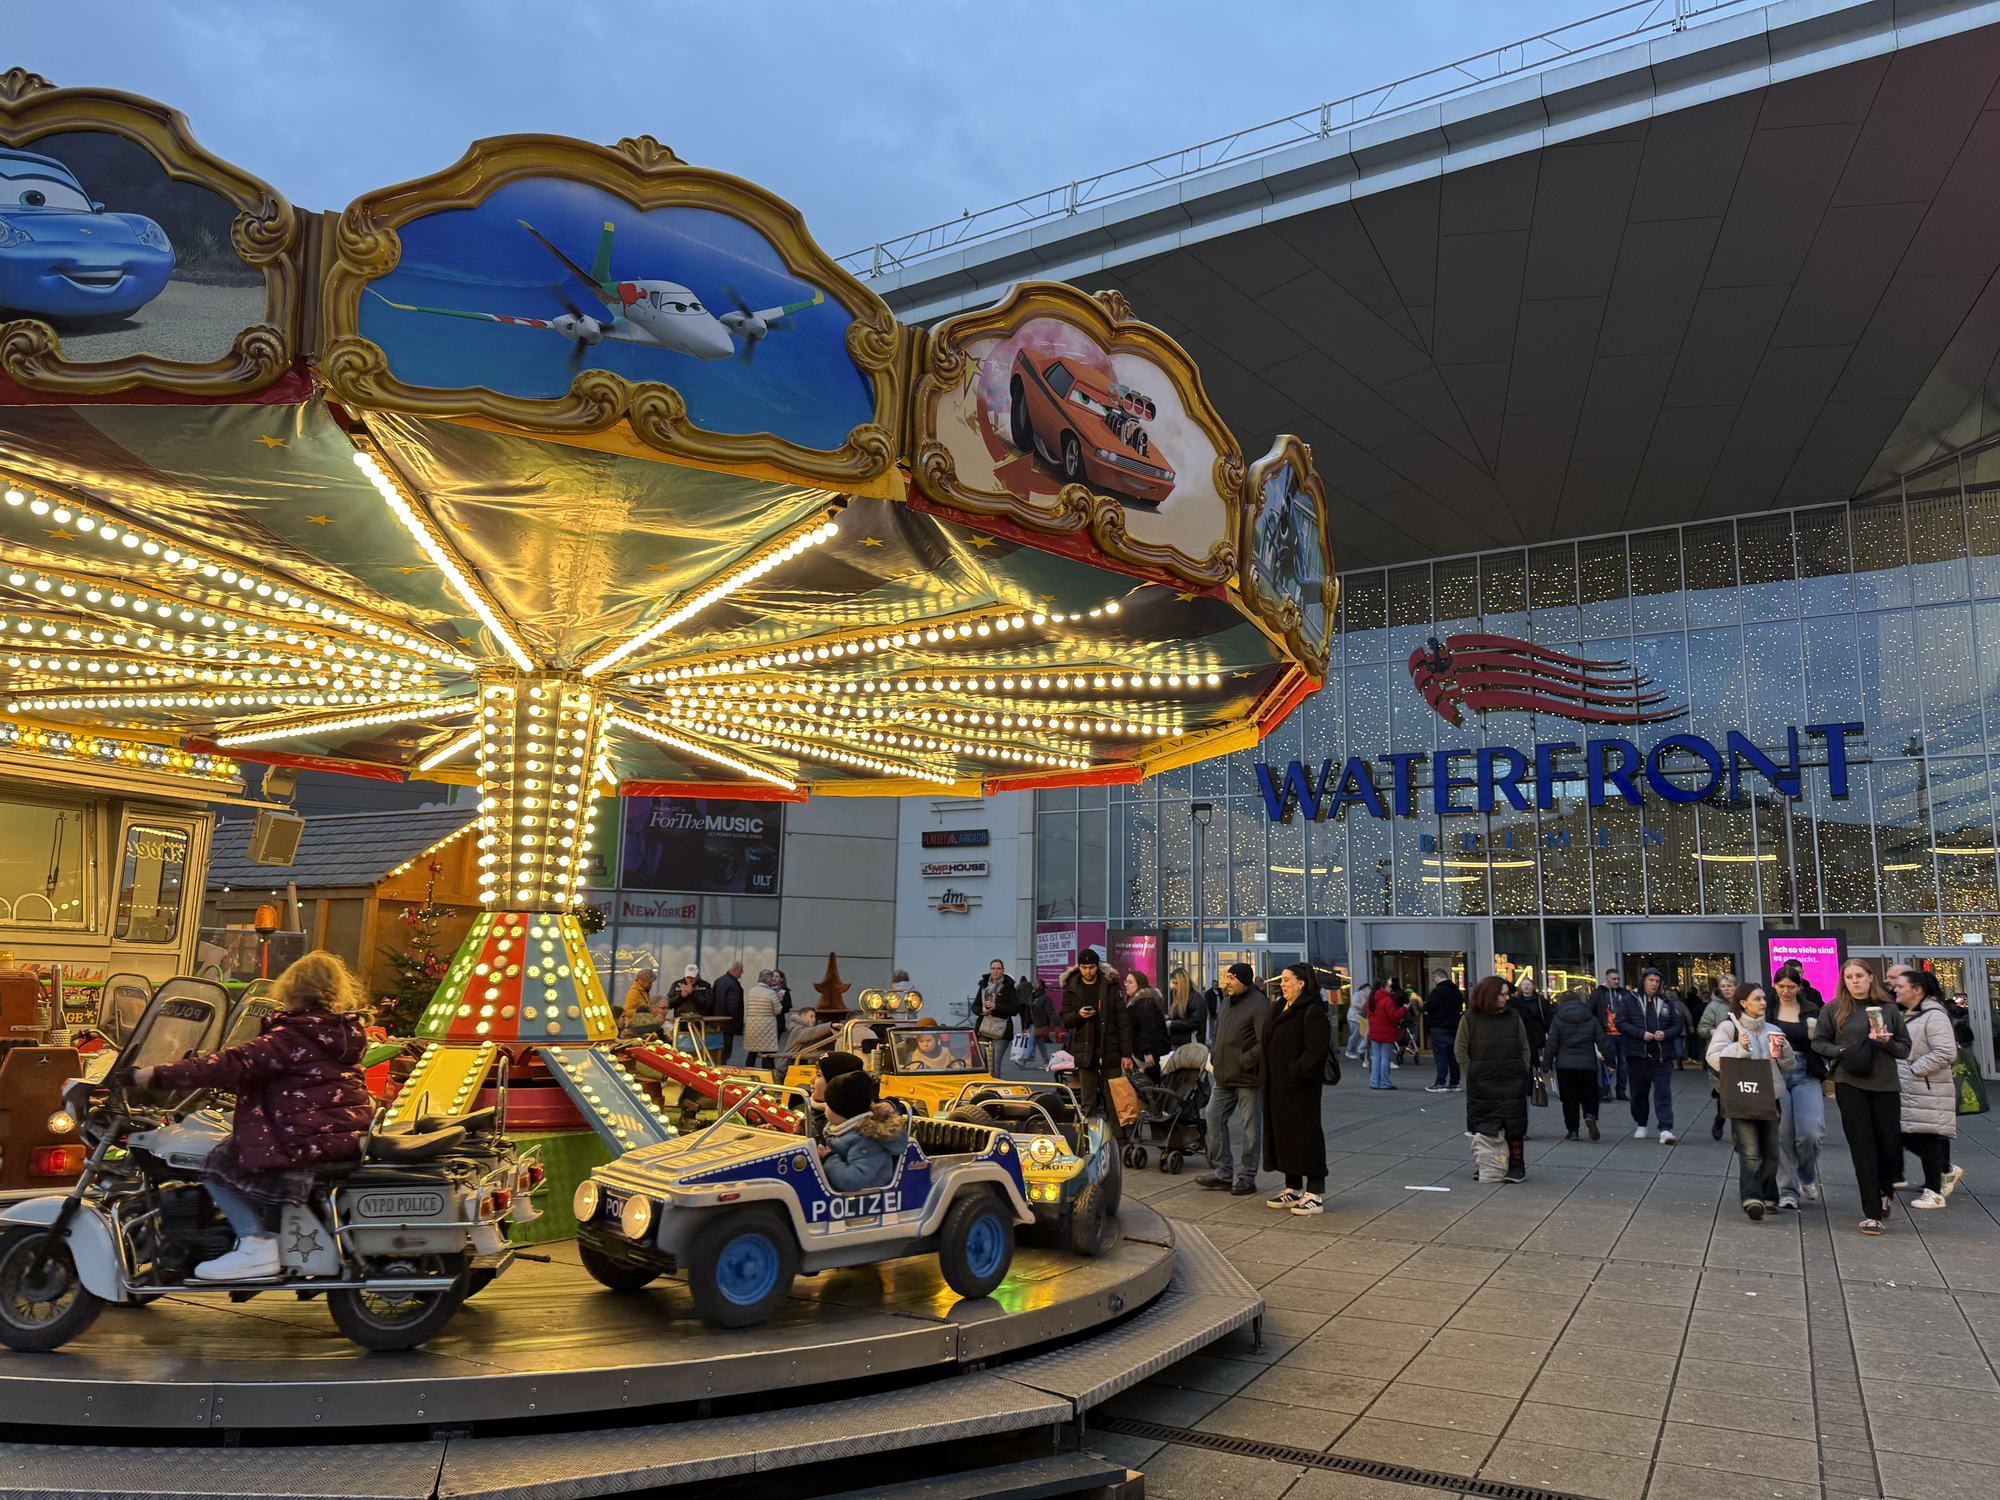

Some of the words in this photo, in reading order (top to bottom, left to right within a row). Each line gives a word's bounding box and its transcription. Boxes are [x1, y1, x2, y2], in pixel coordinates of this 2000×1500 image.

[1254, 721, 1865, 822] WATERFRONT
[1419, 826, 1663, 853] BREMEN
[752, 874, 773, 887] ULT
[942, 888, 963, 904] dm
[1773, 946, 1787, 954] Ach
[1798, 946, 1817, 954] viele
[1818, 946, 1834, 954] sind
[777, 1157, 789, 1176] 6
[363, 1198, 394, 1213] NYPD
[397, 1196, 437, 1212] POLICE
[812, 1190, 902, 1222] POLIZEI
